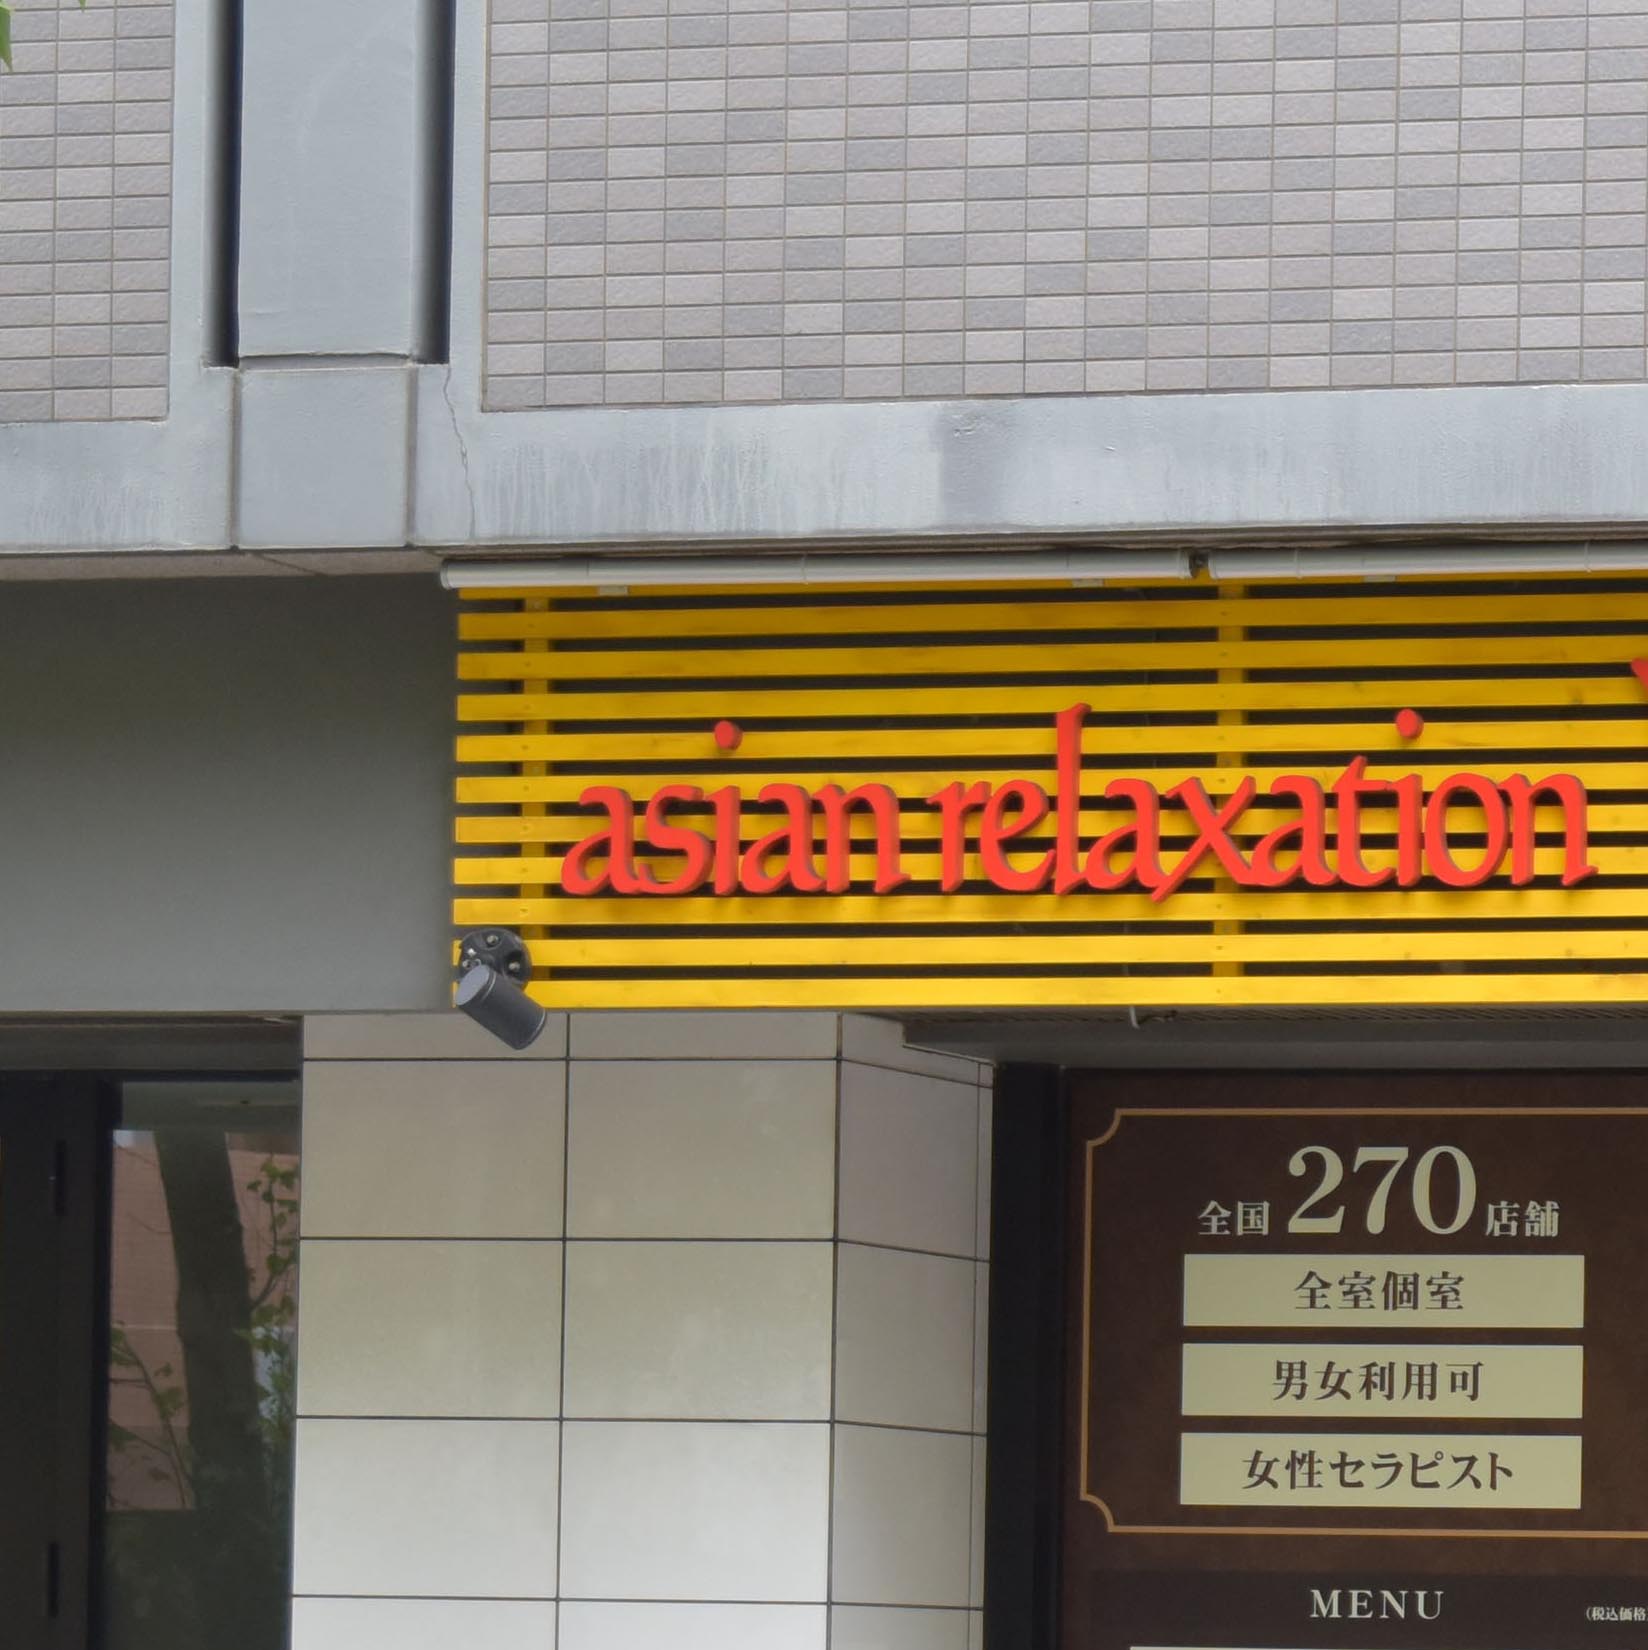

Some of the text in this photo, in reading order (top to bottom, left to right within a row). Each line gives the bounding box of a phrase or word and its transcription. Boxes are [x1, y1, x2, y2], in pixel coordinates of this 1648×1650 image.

[560, 719, 910, 898] asian
[927, 701, 1599, 902] relaxation
[1197, 1145, 1560, 1239] 全国 270 店舗
[1294, 1270, 1465, 1311] 全室個室
[1272, 1360, 1484, 1401] 男女利用可
[1243, 1450, 1514, 1491] 女性セラピスト
[1310, 1590, 1445, 1619] MENU
